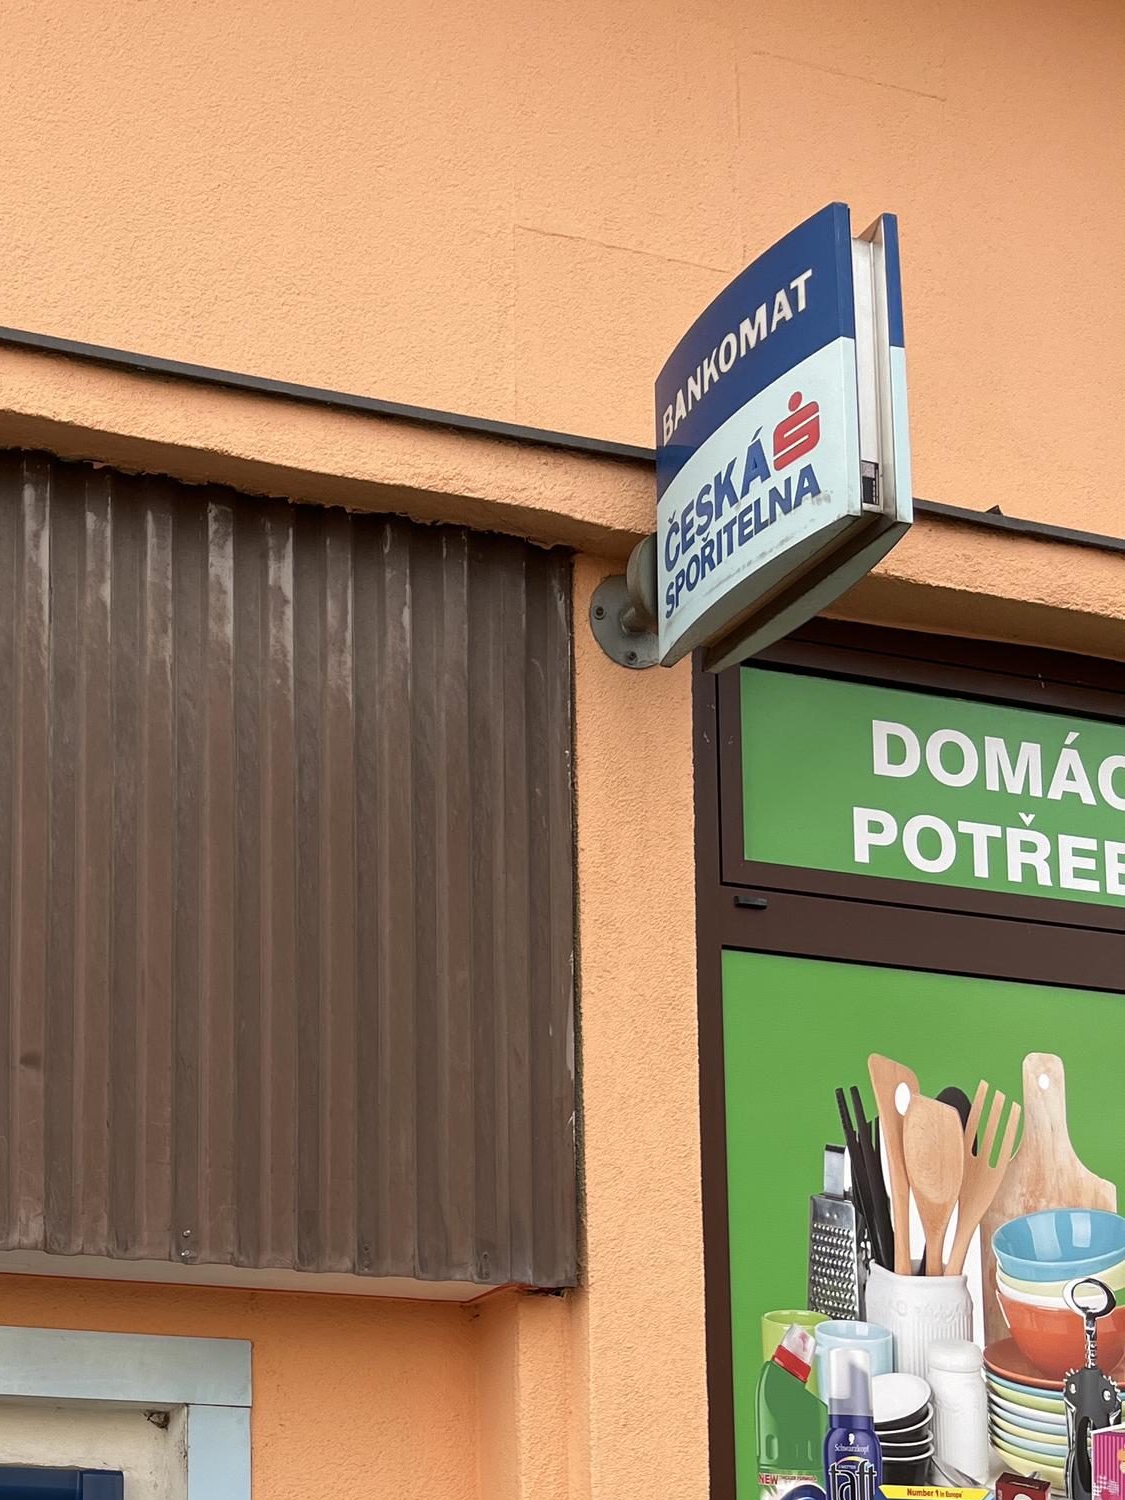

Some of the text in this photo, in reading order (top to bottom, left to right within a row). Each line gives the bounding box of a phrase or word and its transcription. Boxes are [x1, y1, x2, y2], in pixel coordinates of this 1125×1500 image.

[661, 269, 814, 447] BANKOMAT
[664, 427, 772, 572] ČESKÁ
[664, 464, 821, 620] SPOŘITELNA
[759, 1472, 779, 1485] NEW
[835, 1443, 870, 1454] Schwarzkopf
[907, 1488, 933, 1497] Number
[935, 1489, 939, 1497] 1
